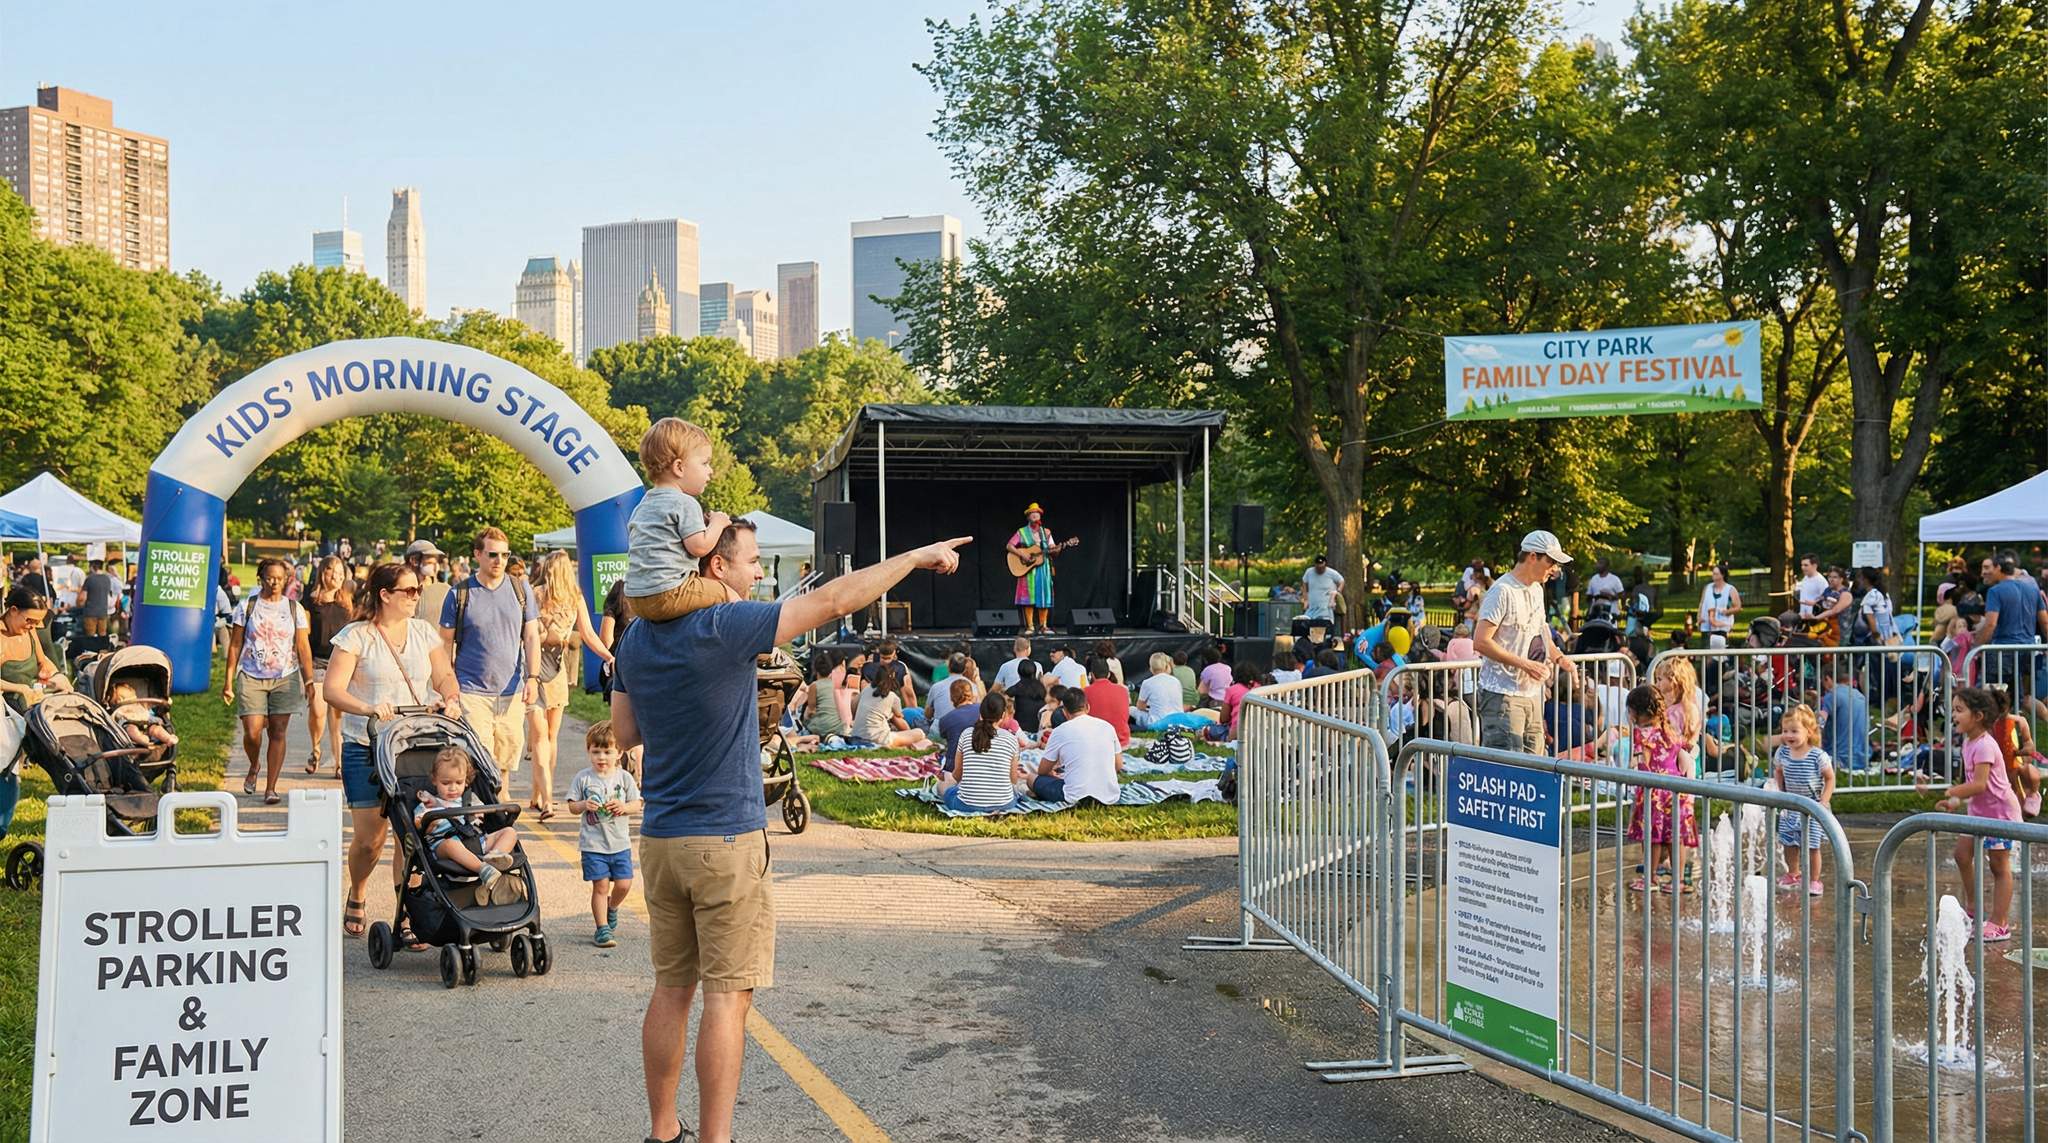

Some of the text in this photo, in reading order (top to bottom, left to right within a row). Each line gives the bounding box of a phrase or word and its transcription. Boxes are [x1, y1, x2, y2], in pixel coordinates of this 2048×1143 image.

[1544, 336, 1654, 360] CITY PARK
[1463, 355, 1743, 390] FAMILY DAY FESTIVAL
[307, 359, 493, 404] MORNING
[497, 385, 601, 476] STAGE
[151, 549, 205, 563] STROLLER
[153, 563, 199, 575] PARKING
[152, 575, 199, 588] & FAMILY
[159, 589, 190, 600] ZONE
[1458, 772, 1506, 798] SPLASH
[1509, 780, 1537, 803] PAD
[1458, 795, 1546, 831] SAFETY FIRST
[83, 904, 303, 947] STROLLER
[97, 947, 288, 991] PARKING
[178, 996, 207, 1031] &
[114, 1037, 269, 1081] FAMILY
[129, 1083, 250, 1127] ZONE
